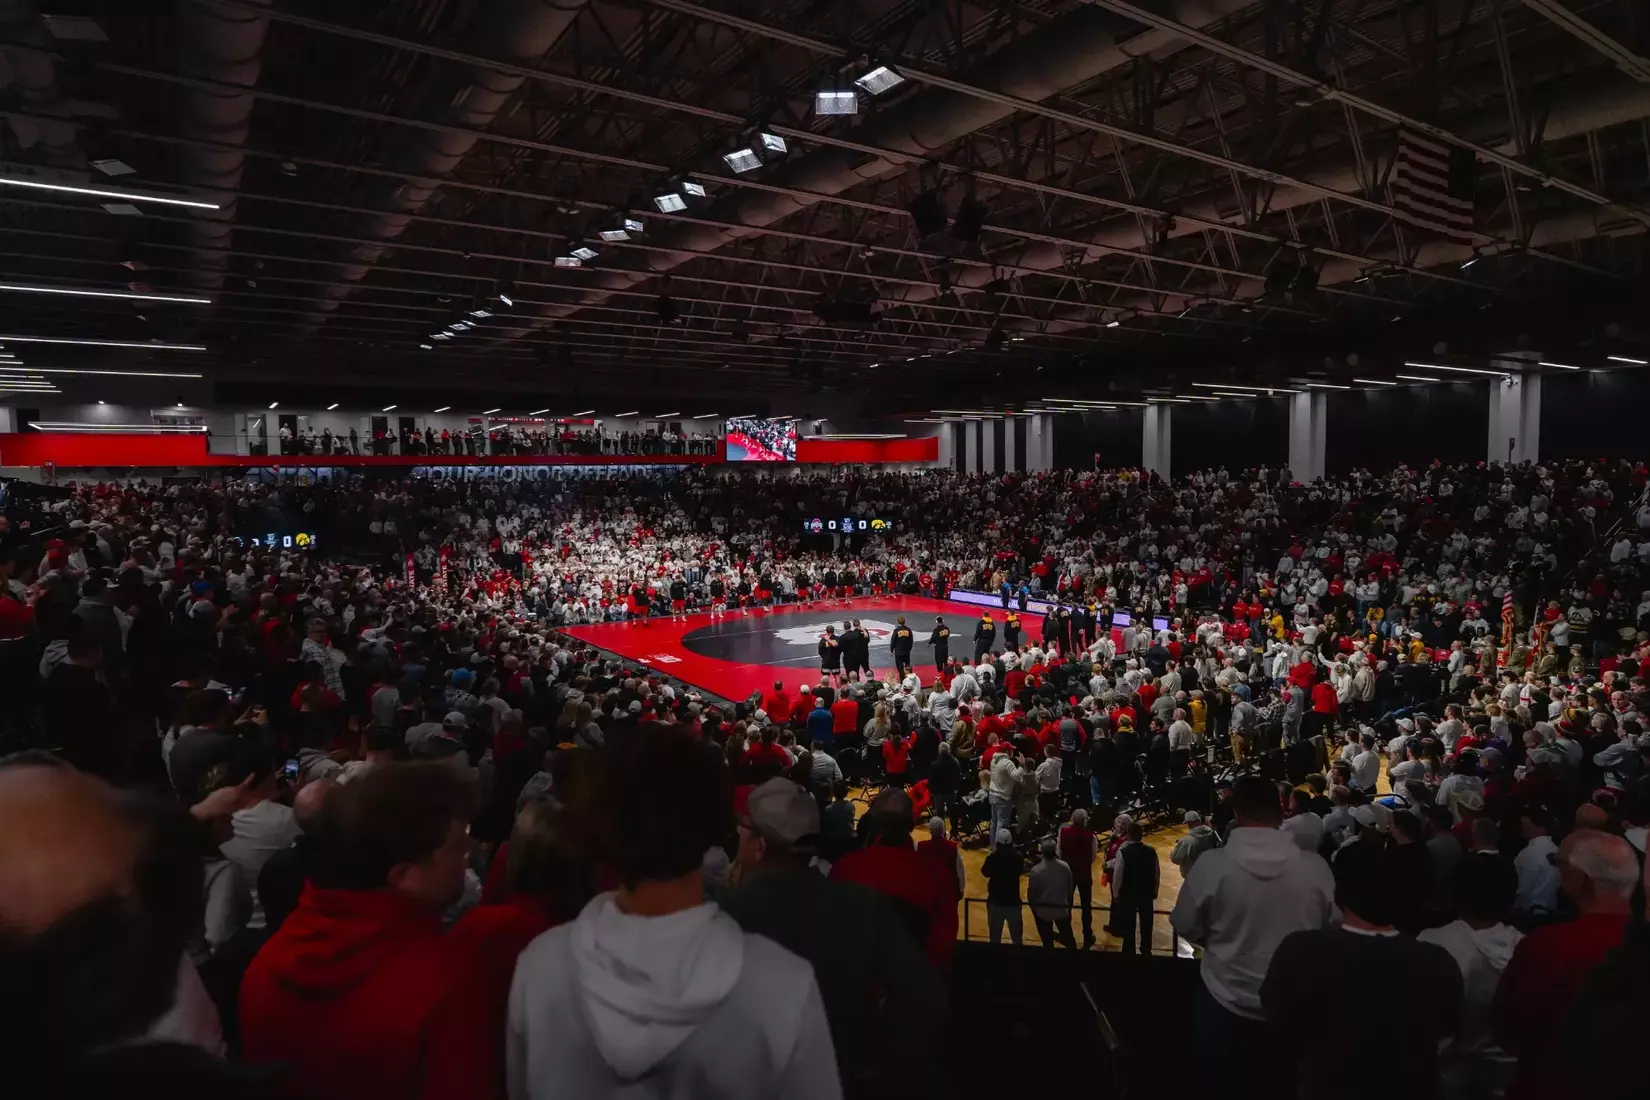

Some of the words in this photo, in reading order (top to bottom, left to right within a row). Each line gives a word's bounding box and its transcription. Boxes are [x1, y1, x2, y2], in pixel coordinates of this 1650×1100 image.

[827, 519, 837, 530] 0
[858, 519, 868, 530] 0
[282, 535, 292, 548] 0
